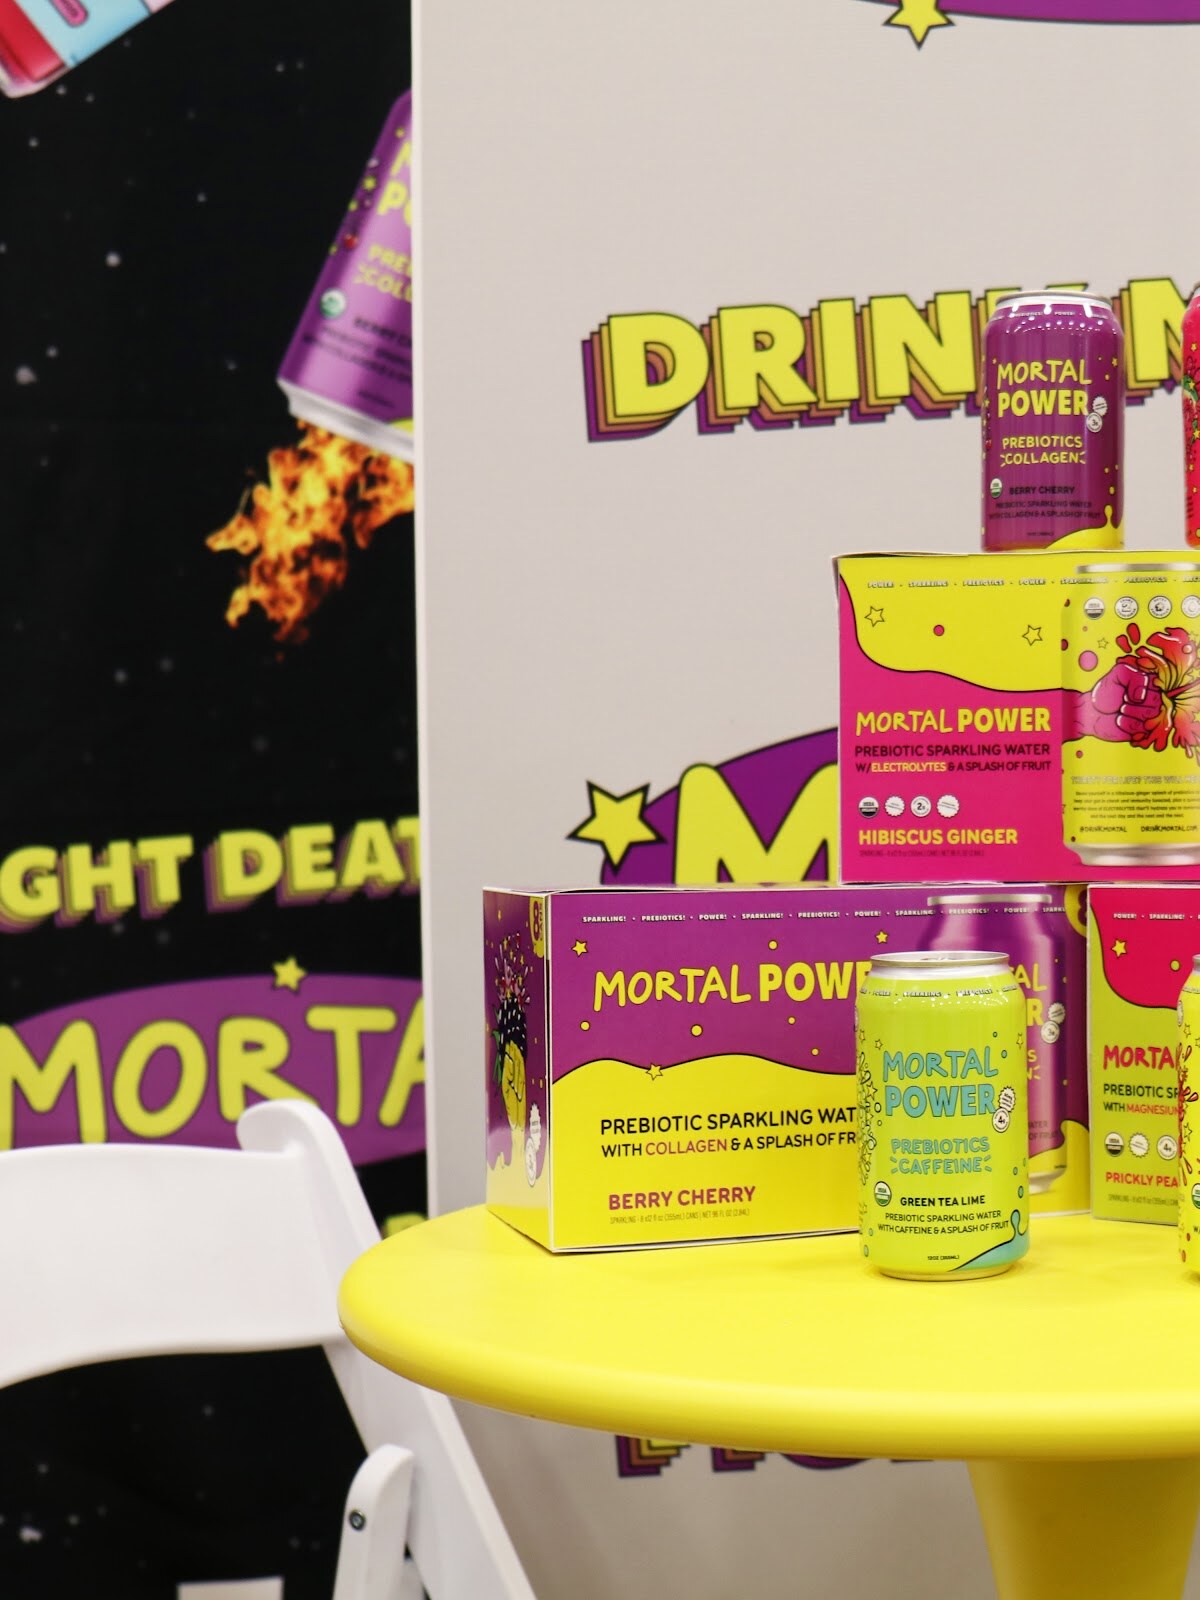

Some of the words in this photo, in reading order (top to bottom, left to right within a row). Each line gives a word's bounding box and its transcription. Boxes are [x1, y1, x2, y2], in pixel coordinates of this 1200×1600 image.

[582, 282, 1090, 442] DRIN
[997, 359, 1092, 390] MORTAL
[998, 389, 1088, 417] POWER
[1002, 436, 1083, 449] PREBIOTICS
[1004, 451, 1079, 464] COLLAGEN
[1010, 487, 1035, 495] BERRY
[1039, 486, 1075, 494] CHERRY
[856, 708, 953, 736] MORTAL
[957, 707, 1051, 733] POWER
[855, 745, 923, 756] PREBIOTIC
[927, 744, 1000, 756] SPARKLING
[1004, 744, 1050, 755] WATER
[948, 762, 954, 771] &
[957, 762, 964, 771] A
[966, 762, 1003, 771] SPLASH
[1005, 762, 1019, 771] OF
[1022, 761, 1051, 770] FRUIT
[859, 830, 943, 845] HIBISCUS
[947, 829, 1018, 845] GINGER
[533, 900, 540, 941] 8
[582, 915, 626, 923] SPARKLING!
[698, 913, 727, 921] POWER!
[741, 912, 783, 920] SPARKLING!
[797, 911, 840, 919] PREBIOTICS!
[593, 963, 751, 1012] MORTAL
[882, 1046, 999, 1083] MORTAL
[1103, 1084, 1163, 1098] PREBIOTIC
[884, 1084, 996, 1118] POWER
[1103, 1102, 1125, 1112] WITH
[601, 1115, 702, 1136] PREBIOTIC
[707, 1109, 813, 1130] SPARKLING
[817, 1107, 857, 1124] WAT
[601, 1143, 643, 1158] WITH
[646, 1139, 728, 1156] COLLAGEN
[731, 1138, 741, 1151] &
[743, 1137, 754, 1150] A
[757, 1132, 813, 1149] SPLASH
[816, 1133, 835, 1146] OF
[838, 1132, 856, 1144] FR
[891, 1137, 990, 1155] PREBIOTICS
[898, 1157, 983, 1175] CAFFEINE
[1105, 1172, 1153, 1186] PRICKLY
[1156, 1176, 1178, 1187] PEA
[608, 1191, 673, 1210] BERRY
[677, 1186, 756, 1206] CHERRY
[900, 1197, 936, 1206] GREEN
[939, 1197, 958, 1206] TEA
[961, 1195, 985, 1205] LIME
[885, 1213, 925, 1223] PREBIOTIC
[927, 1212, 974, 1222] SPARKLING
[977, 1210, 1001, 1220] WATER
[878, 1224, 895, 1233] WITH
[895, 1225, 932, 1234] CAFFEINE
[947, 1224, 978, 1234] SPLASH
[980, 1223, 989, 1231] OF
[991, 1220, 1009, 1230] FRUIT
